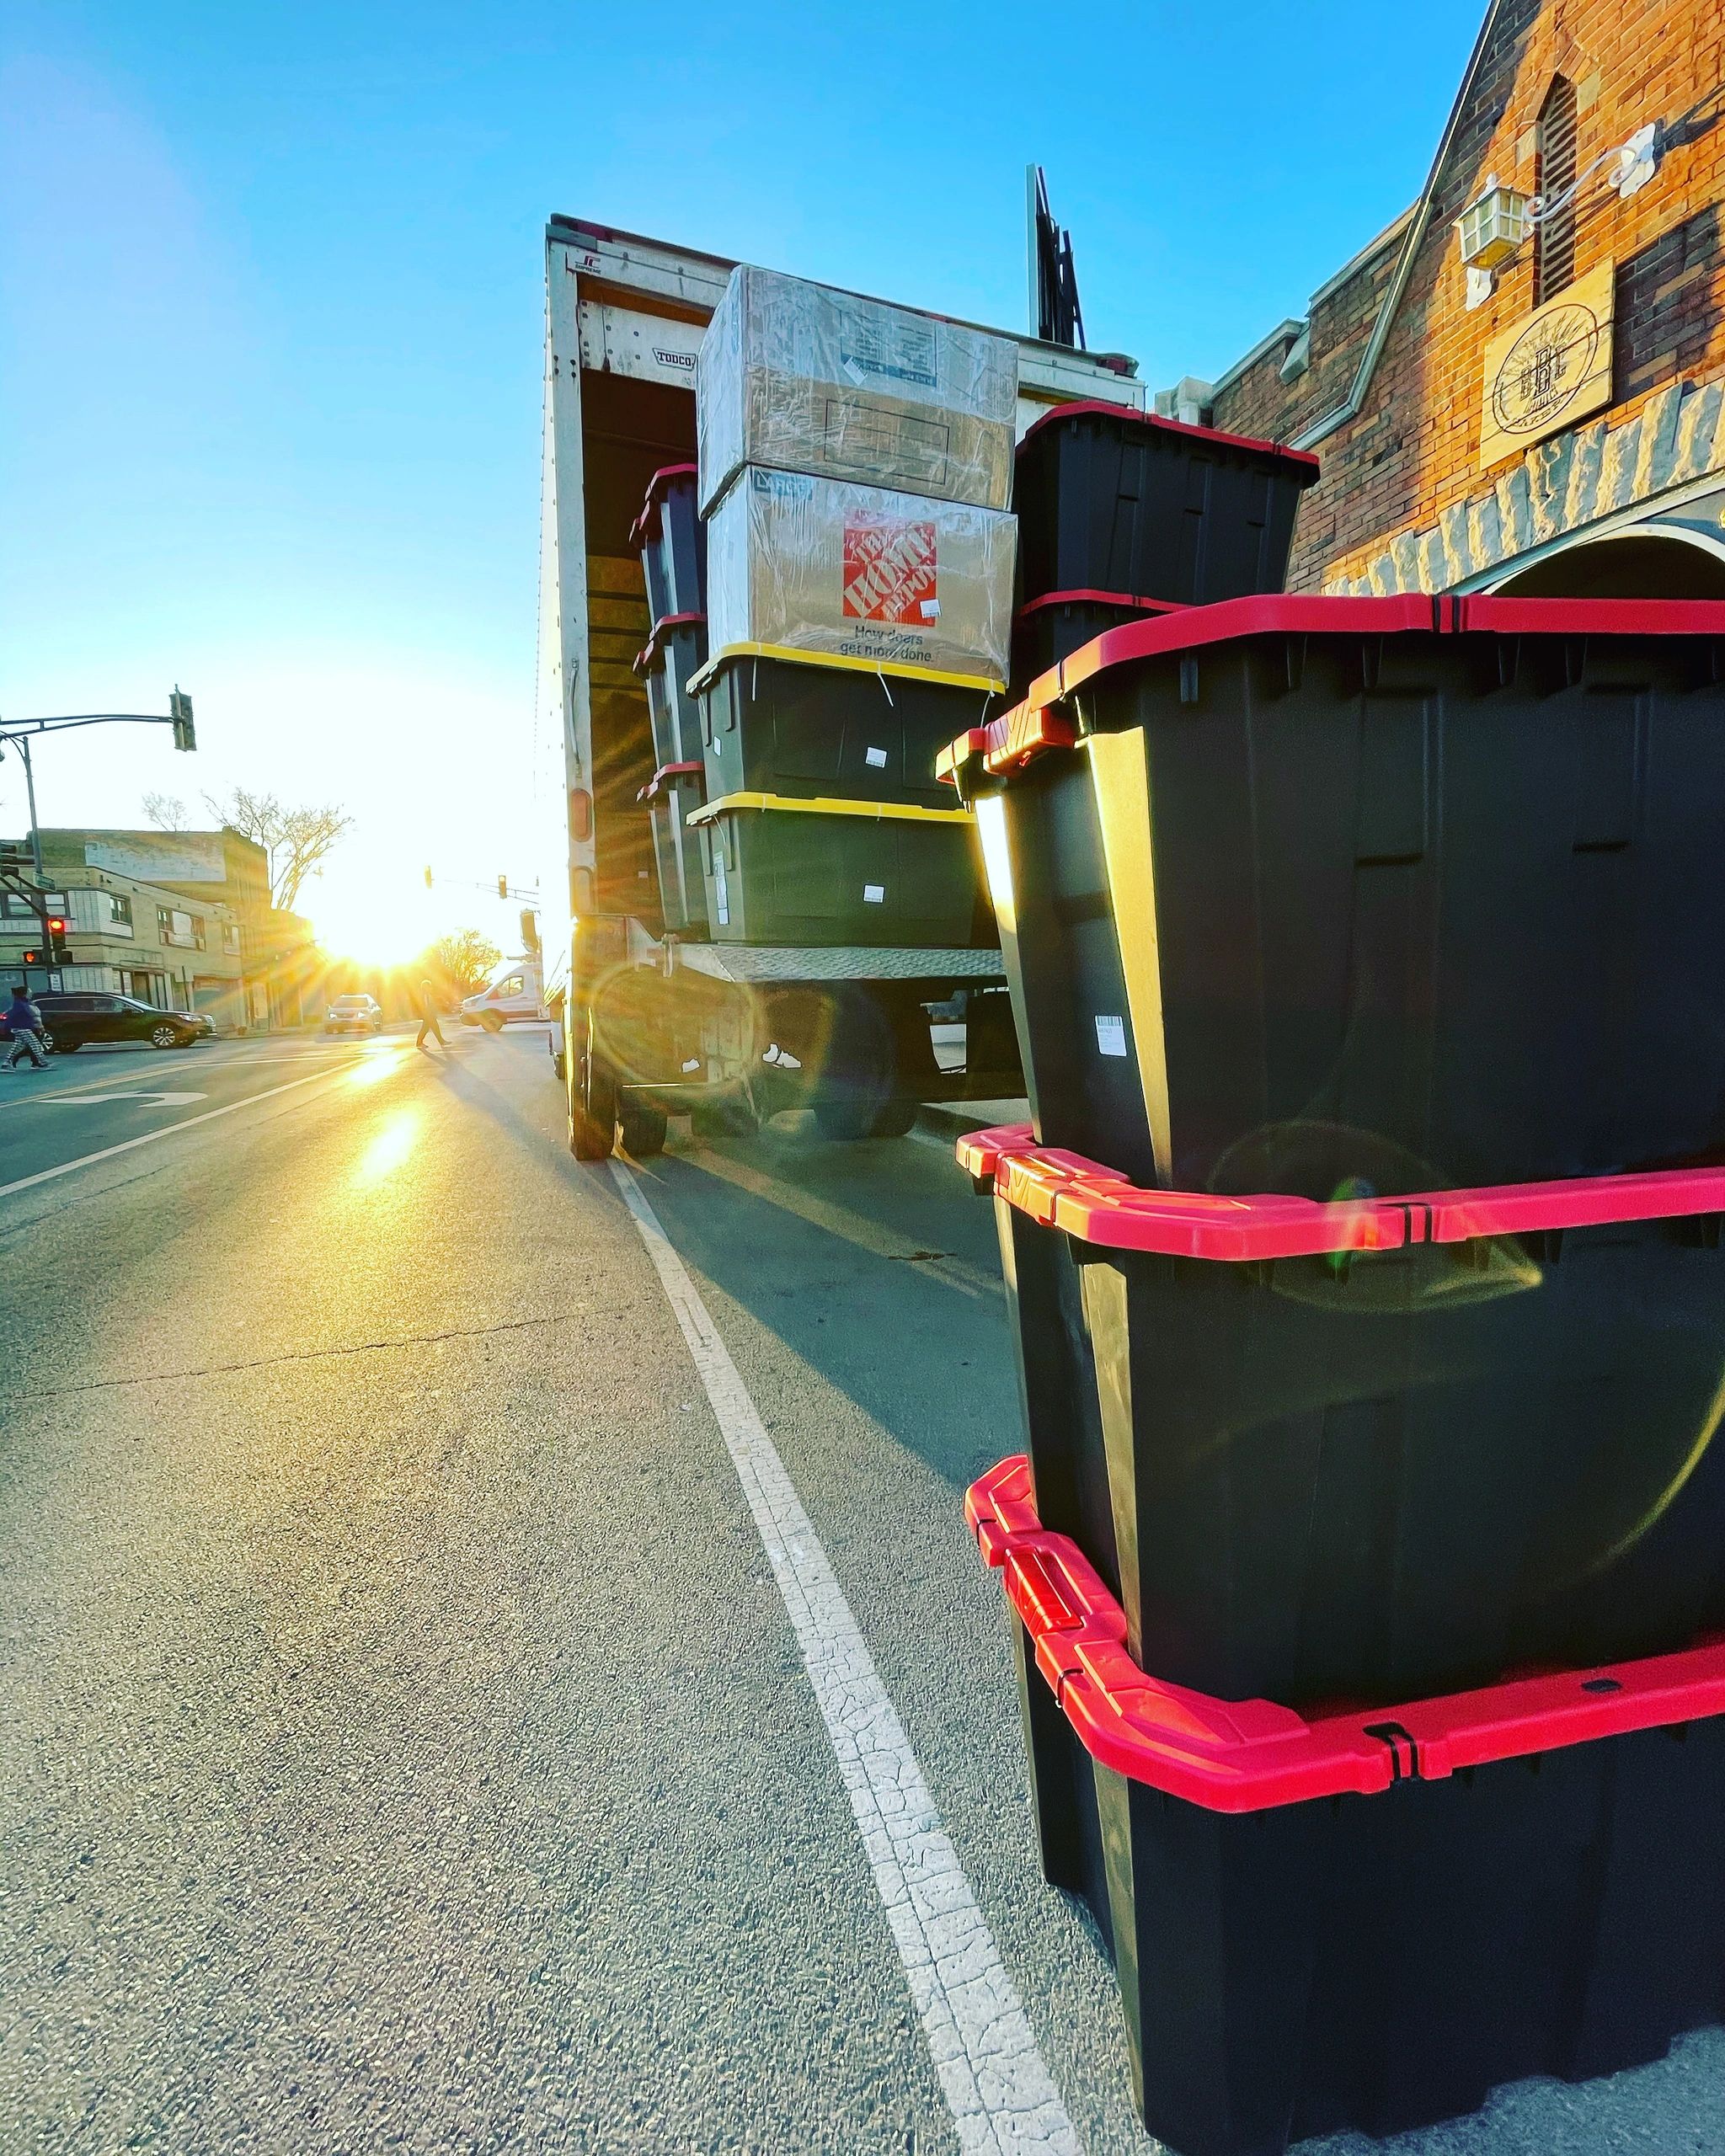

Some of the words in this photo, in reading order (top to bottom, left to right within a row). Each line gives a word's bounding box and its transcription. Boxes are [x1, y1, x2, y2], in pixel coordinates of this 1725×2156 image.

[657, 351, 692, 366] TODCO
[855, 625, 884, 639] How
[840, 642, 862, 655] get
